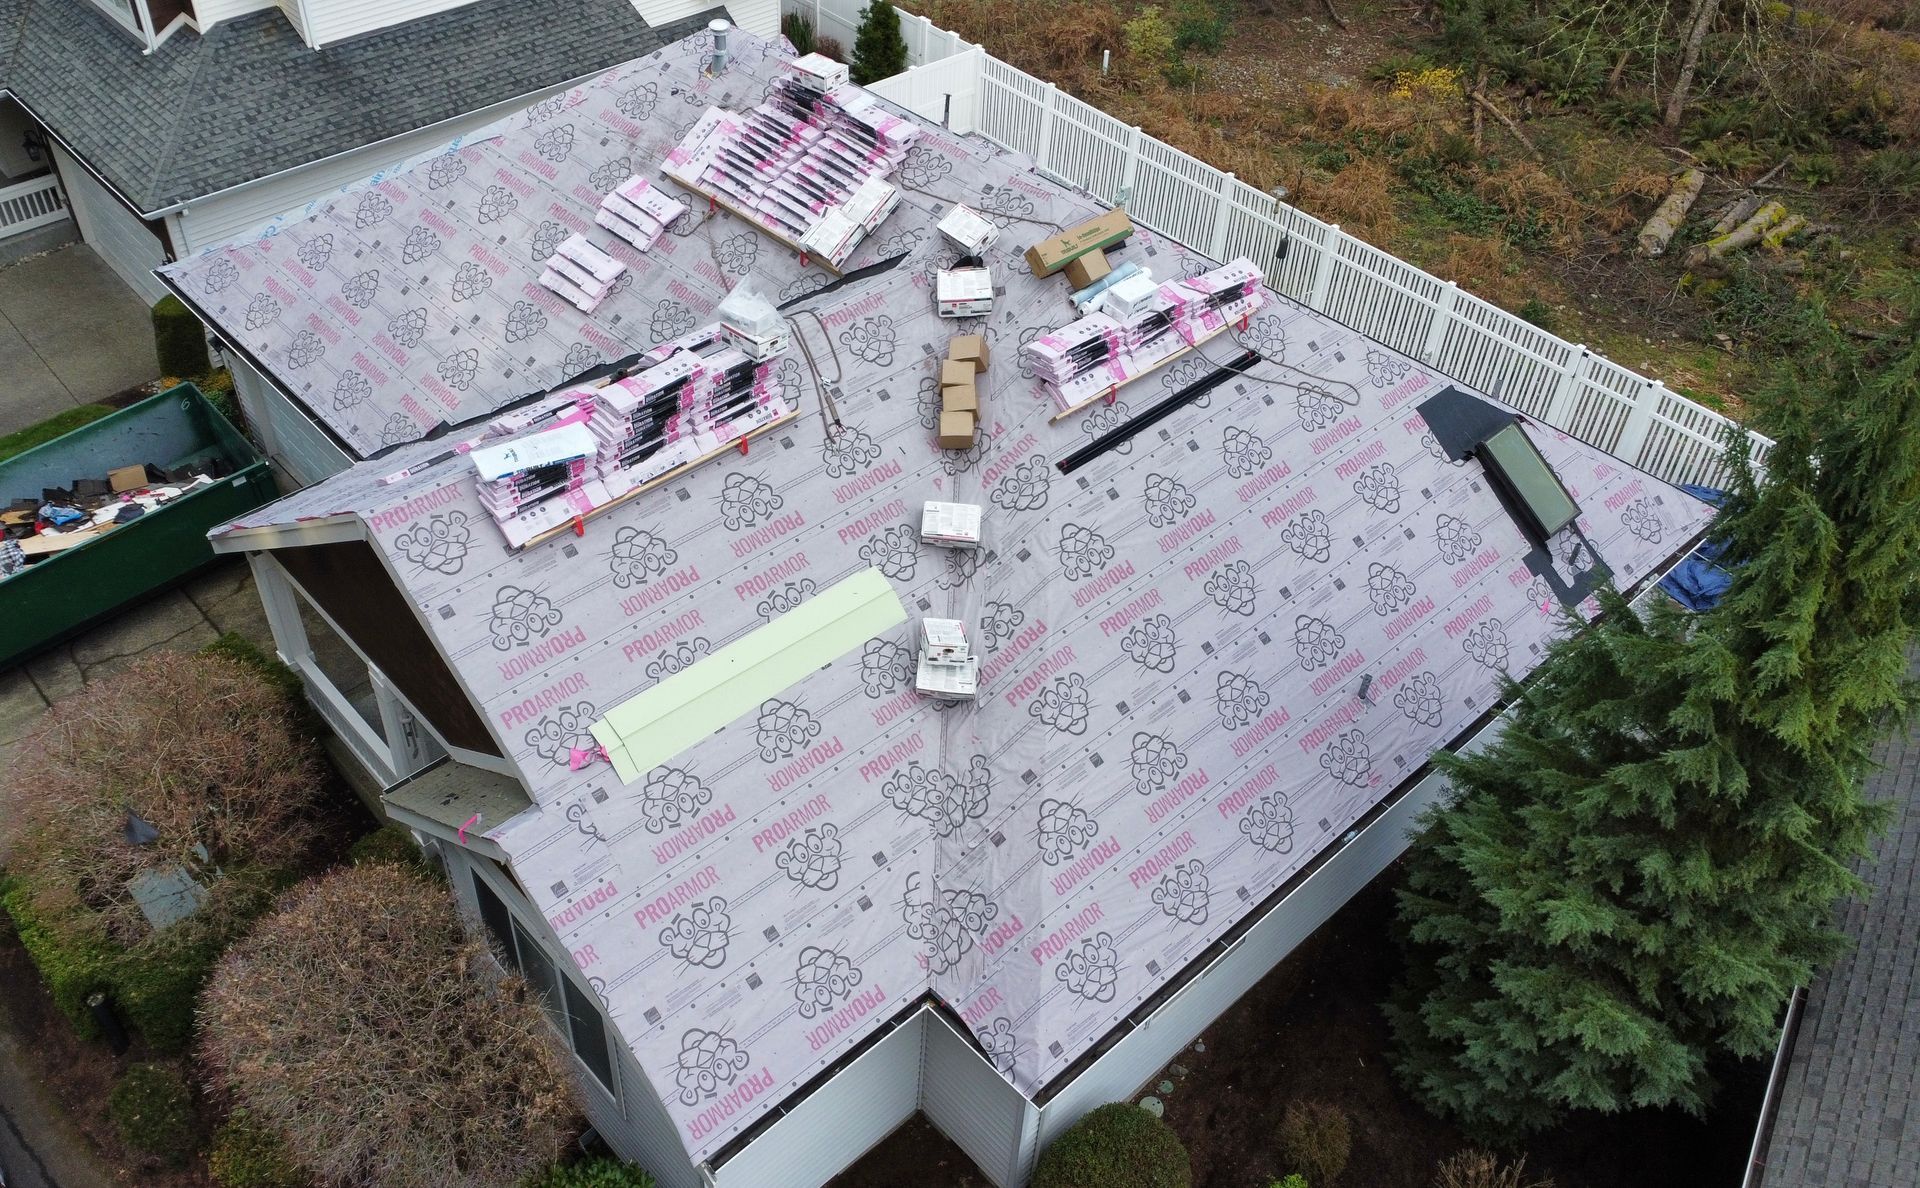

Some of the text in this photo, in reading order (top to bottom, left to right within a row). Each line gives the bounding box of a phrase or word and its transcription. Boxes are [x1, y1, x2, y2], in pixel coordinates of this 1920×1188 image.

[832, 458, 903, 504] PROARMOR
[370, 483, 463, 534] PROARMOR
[729, 509, 806, 559] PROARMOR
[837, 498, 908, 545] PROARMOR
[1156, 508, 1217, 554] PROARMOR
[734, 551, 811, 601] PROARMOR
[1071, 559, 1136, 608] PROARMOR
[1183, 534, 1243, 581] PROARMOR
[1450, 546, 1500, 589] PROARMOR
[619, 564, 701, 617] PROARMOR
[1099, 588, 1163, 637] PROARMOR
[1382, 594, 1436, 640] PROARMOR
[1443, 594, 1495, 639] PROARMOR
[497, 624, 588, 682] PROARMOR
[622, 609, 705, 663] PROARMOR
[1005, 645, 1077, 708] PROARMOR
[1309, 648, 1365, 696] PROARMOR
[500, 671, 590, 731] PROARMOR
[1229, 705, 1291, 758] PROARMOR
[767, 736, 845, 792] PROARMOR
[1144, 767, 1211, 824] PROARMOR
[1217, 763, 1280, 819] PROARMOR
[651, 803, 738, 865] PROARMOR
[751, 793, 832, 853] PROARMOR
[1050, 834, 1121, 896] PROARMOR
[1128, 830, 1197, 890] PROARMOR
[633, 864, 721, 930] PROARMOR
[1030, 901, 1105, 967] PROARMOR
[805, 983, 887, 1052] PROARMOR
[686, 1066, 776, 1141] PROARMOR
